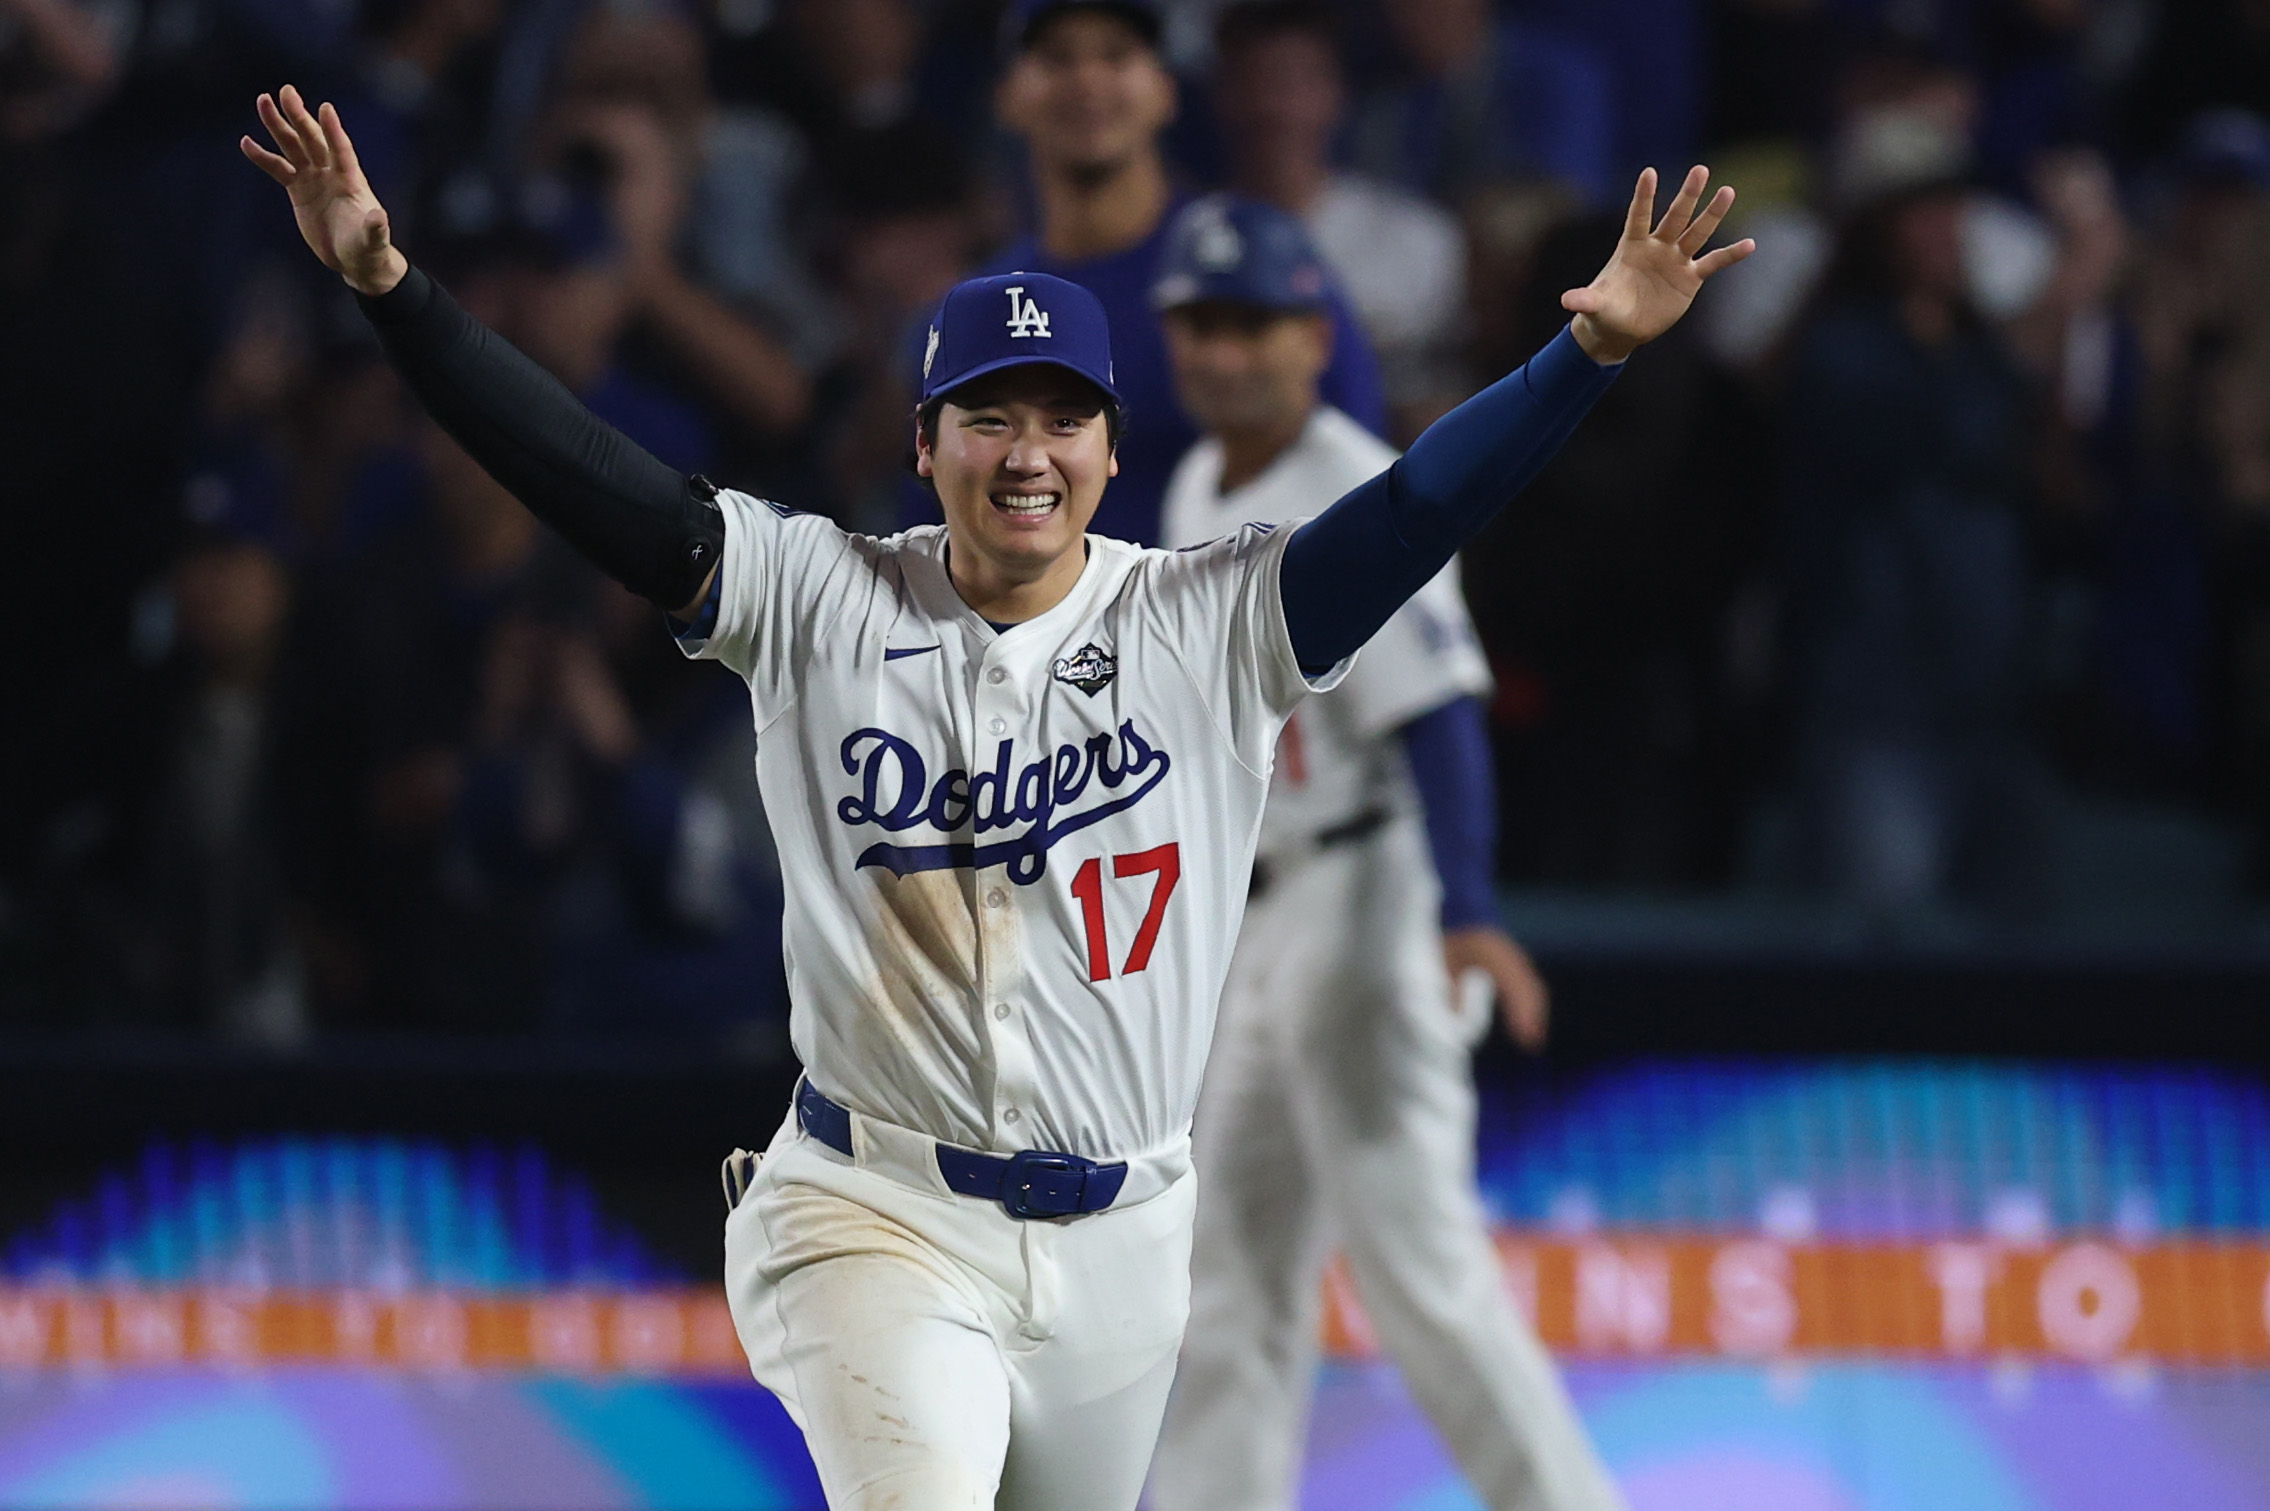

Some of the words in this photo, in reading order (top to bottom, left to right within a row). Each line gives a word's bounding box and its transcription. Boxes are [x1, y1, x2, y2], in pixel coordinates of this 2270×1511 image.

[1005, 287, 1051, 338] LA
[1091, 659, 1116, 680] Seri
[840, 718, 1170, 885] Dodgers
[1071, 842, 1181, 982] 17
[1928, 1240, 2142, 1360] TO
